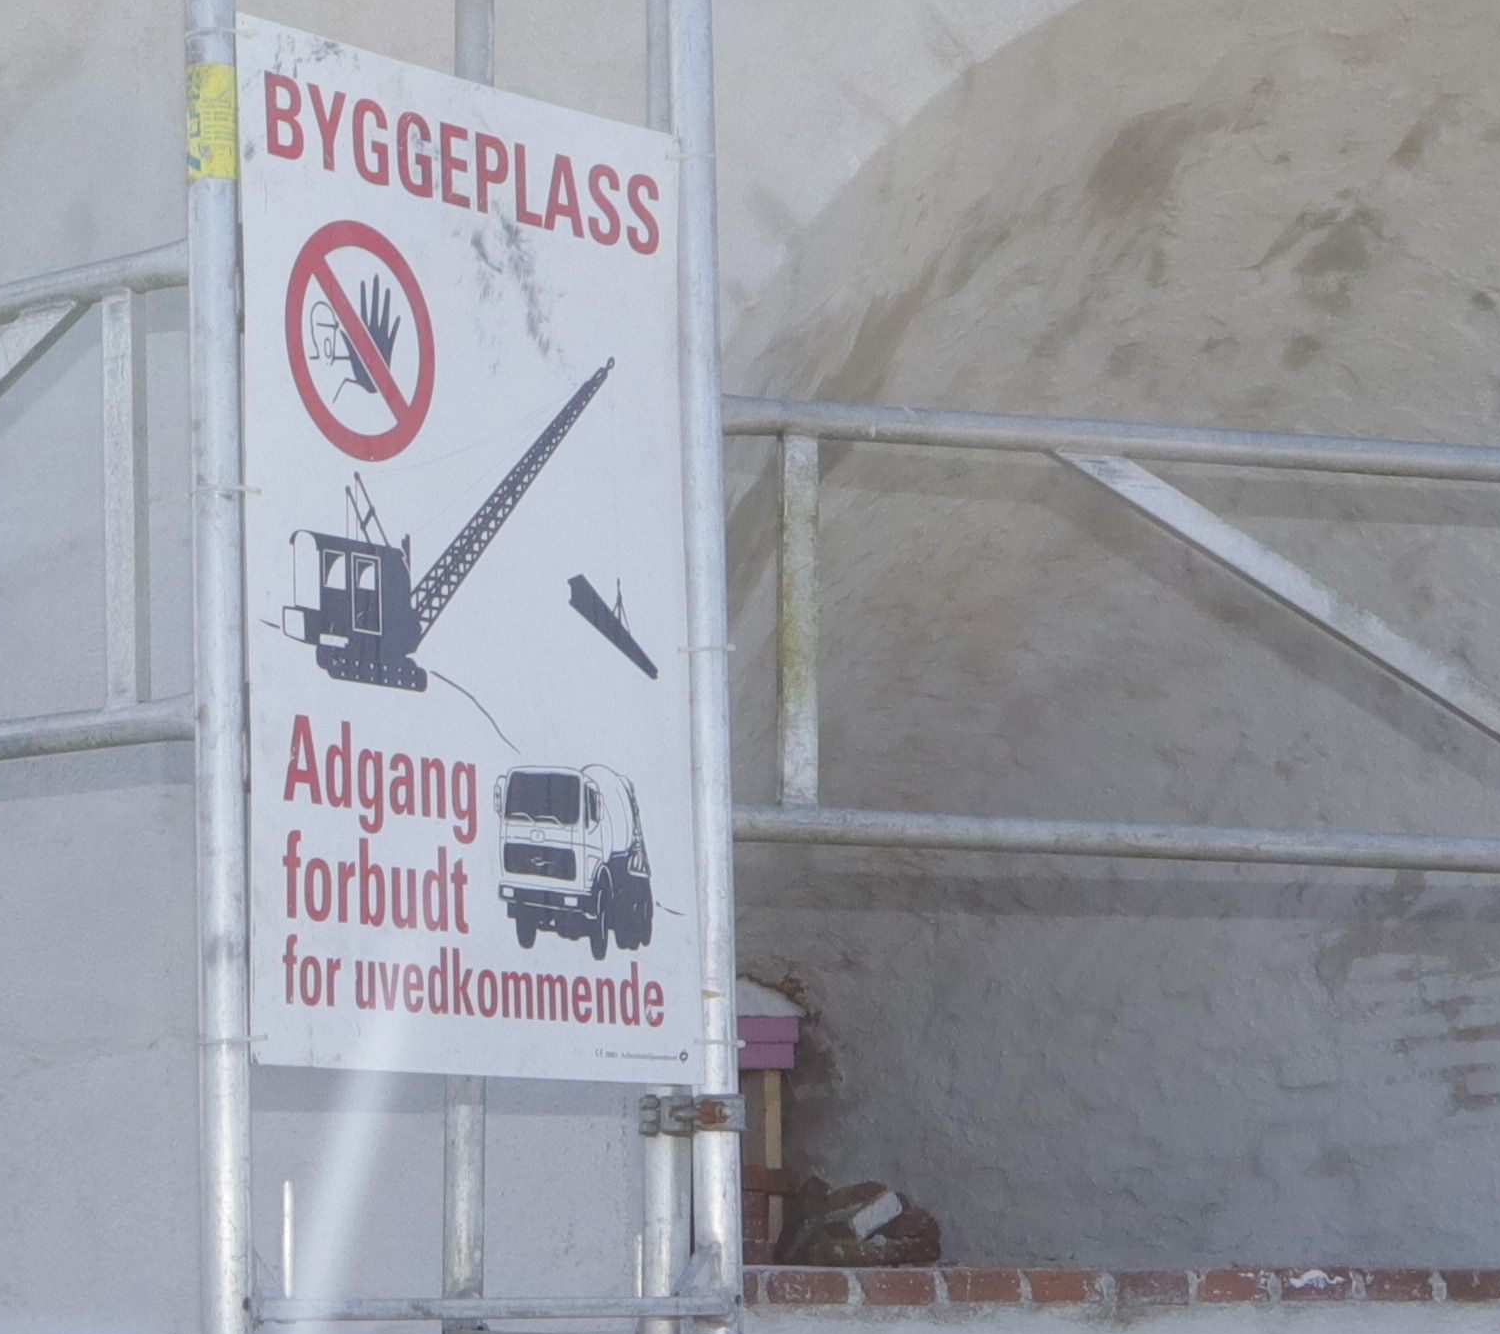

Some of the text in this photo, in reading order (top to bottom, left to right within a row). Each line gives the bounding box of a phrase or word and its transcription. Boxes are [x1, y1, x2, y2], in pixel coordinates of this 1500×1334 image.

[264, 70, 660, 256] BYGGEPLASS
[282, 713, 478, 845] Adgang
[281, 829, 470, 935] forbudt
[282, 934, 665, 1028] for uvedkommende
